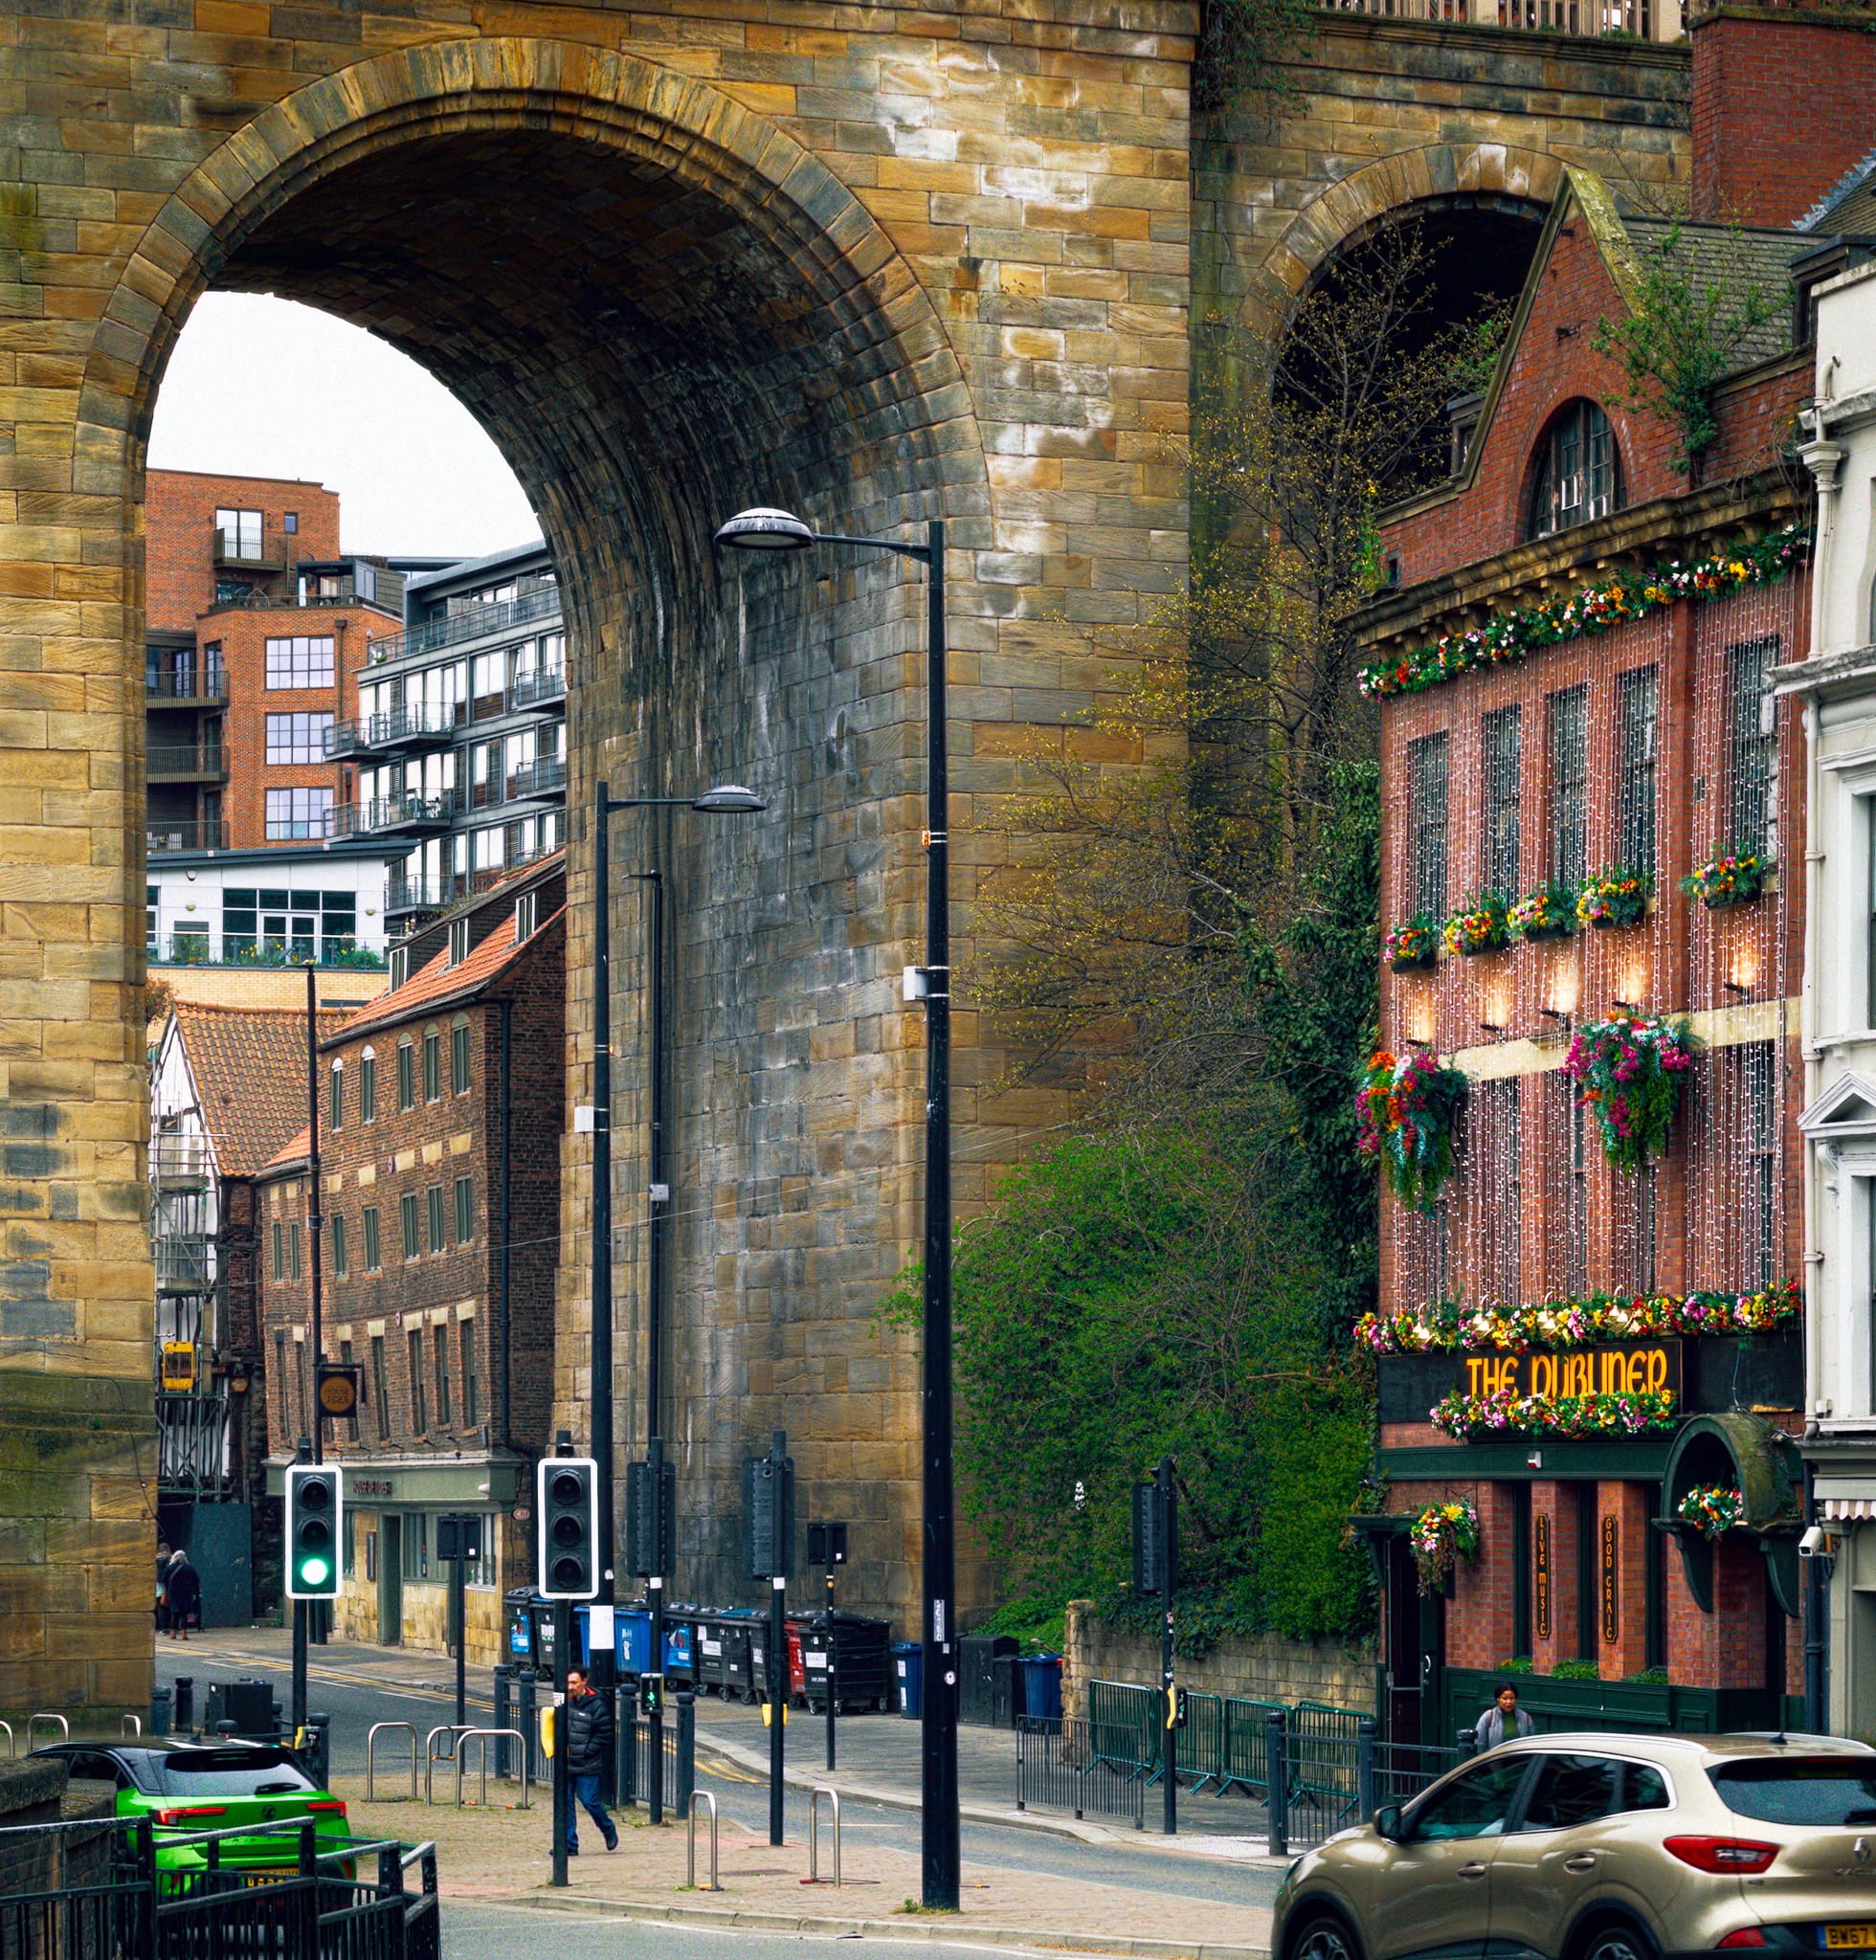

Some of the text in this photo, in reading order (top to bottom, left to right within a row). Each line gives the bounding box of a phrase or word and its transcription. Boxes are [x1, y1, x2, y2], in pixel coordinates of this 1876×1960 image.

[1466, 1348, 1667, 1399] THE DUBLINER
[1538, 1572, 1547, 1635] MUSIC
[1828, 1927, 1869, 1946] BW67
